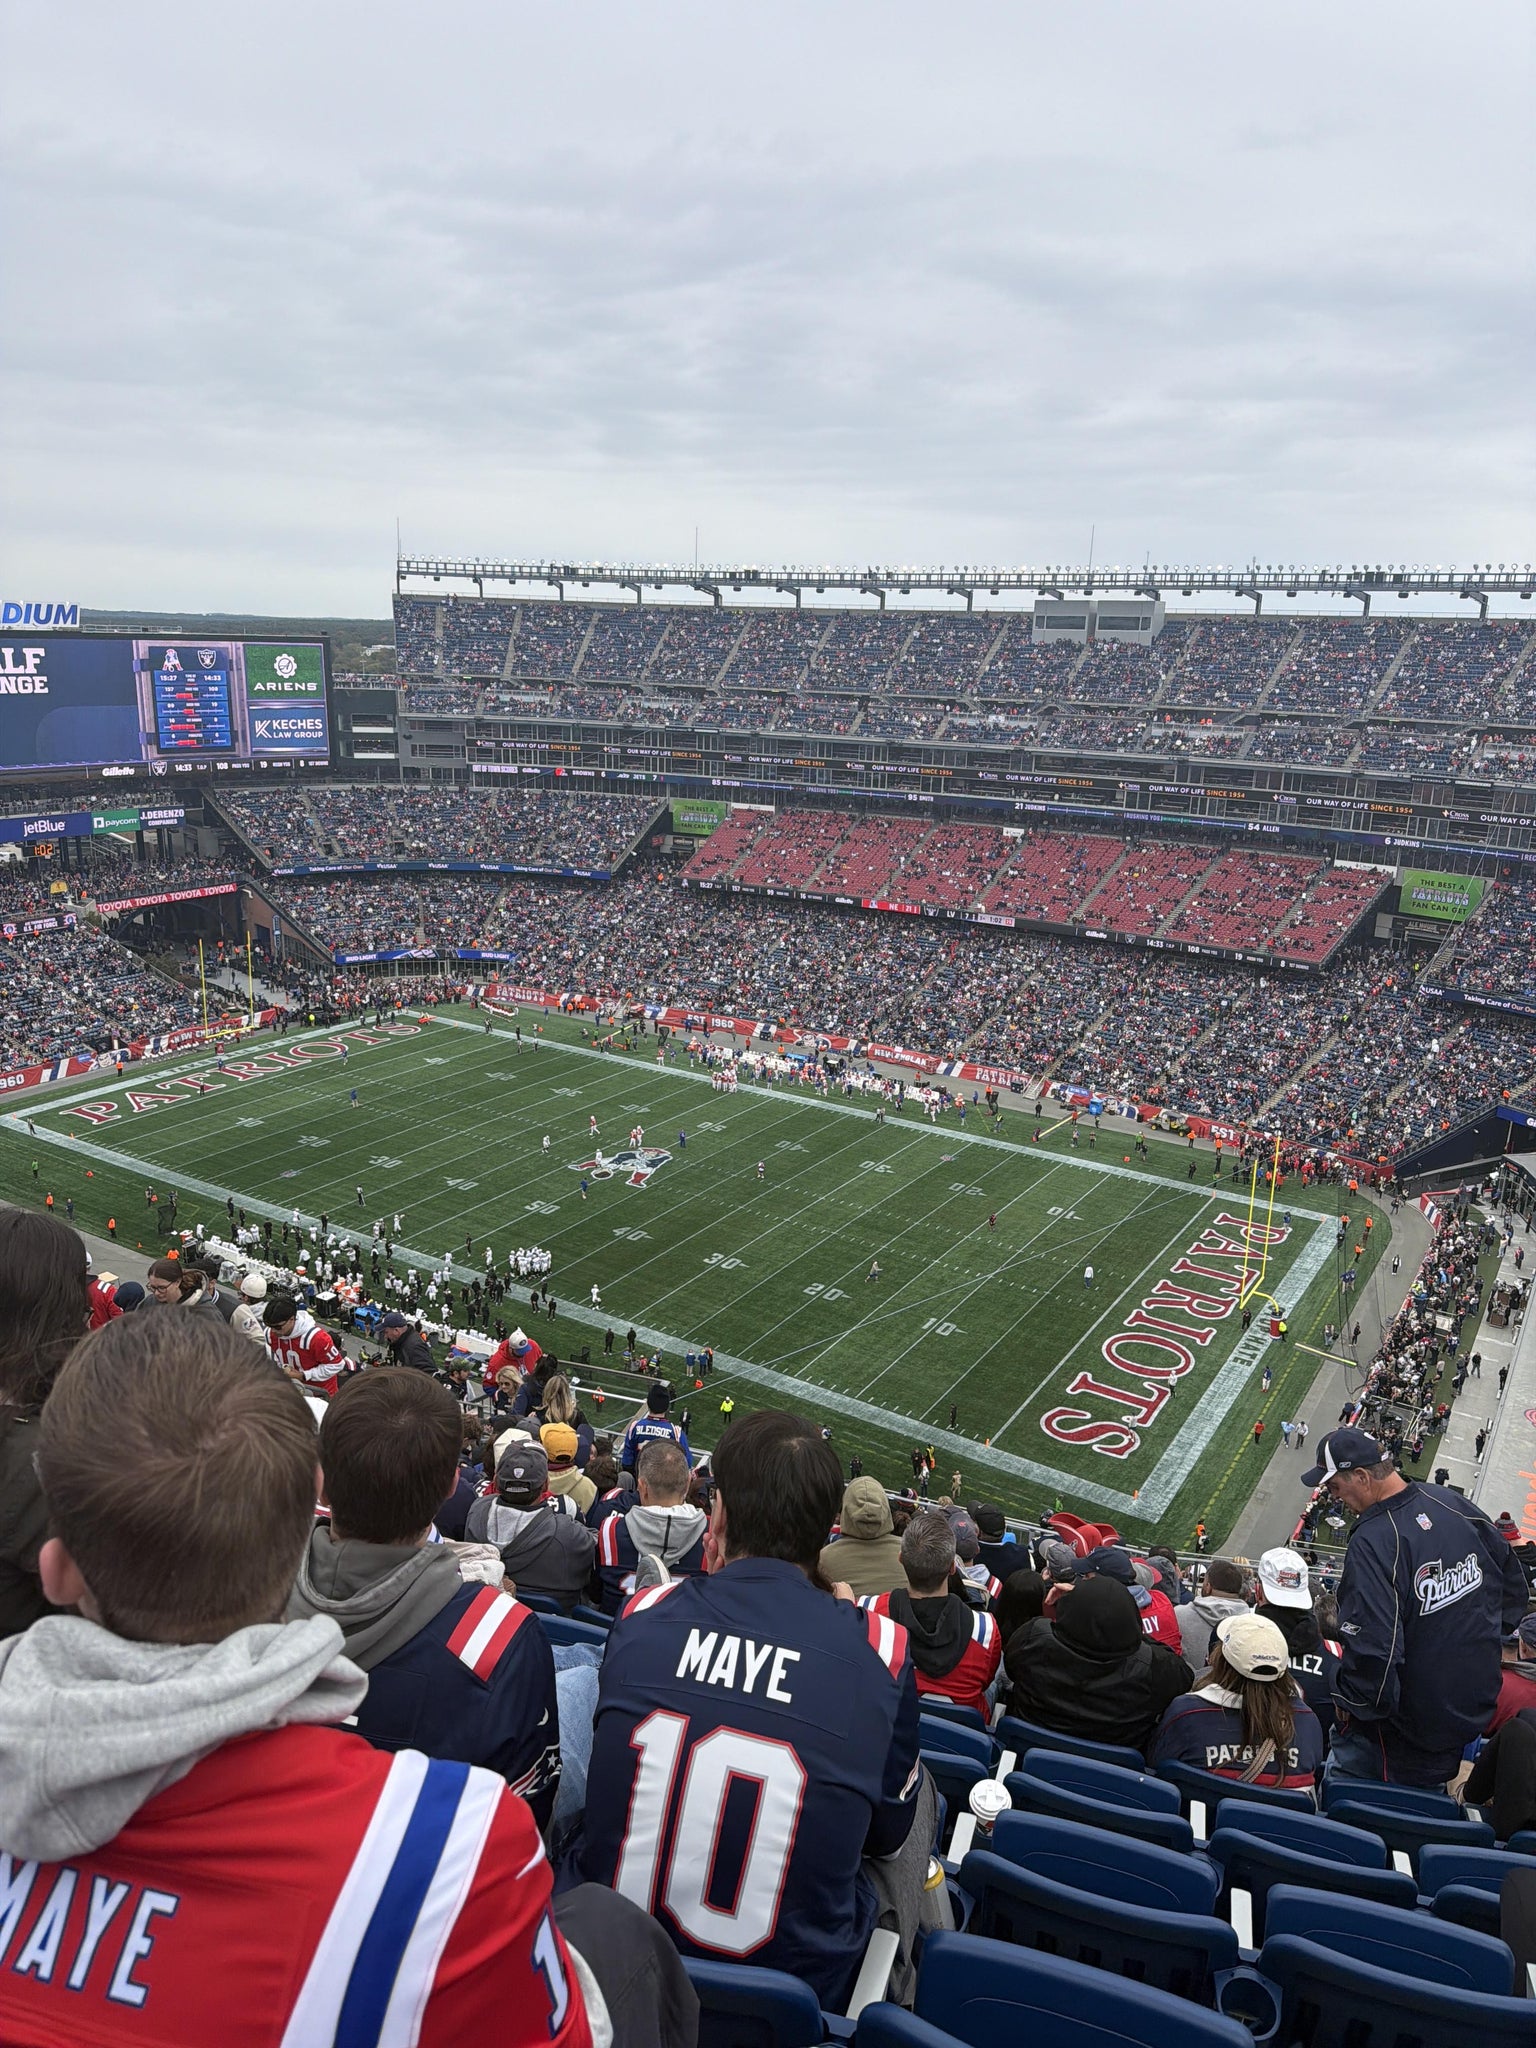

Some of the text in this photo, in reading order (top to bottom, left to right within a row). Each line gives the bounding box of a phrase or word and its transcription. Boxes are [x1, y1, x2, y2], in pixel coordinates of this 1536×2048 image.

[1, 602, 78, 625] DIUM
[0, 647, 45, 674] LF
[0, 676, 48, 694] NGE
[254, 682, 318, 691] ARIENS
[272, 718, 323, 730] KECHES
[273, 730, 323, 739] LAW GROUP
[175, 764, 193, 772] 14:33
[216, 762, 229, 770] 108
[259, 761, 267, 769] 19
[871, 764, 884, 772] OUR
[907, 766, 920, 774] LIFE
[1190, 788, 1205, 796] LIFE
[1206, 789, 1226, 797] SINCE
[1014, 802, 1024, 810] 21
[1306, 797, 1413, 814] OUR WAY OF LIFE SINCE 1954
[105, 816, 137, 828] paycom
[140, 808, 185, 821] J.DERENZO
[147, 818, 178, 826] COMPANIES
[1480, 814, 1498, 823] OUR
[1500, 816, 1517, 824] WAY
[1519, 818, 1532, 826] OF
[23, 820, 65, 837] jetBlue
[1248, 823, 1260, 831] 54
[1262, 824, 1280, 833] ALLEN
[1384, 837, 1391, 845] 6
[1393, 837, 1420, 848] JUDKINS
[34, 844, 54, 856] 1:02
[203, 884, 235, 896] TOYOTA
[1420, 879, 1466, 891] THE BEST A
[134, 895, 168, 907] TOYOTA
[168, 889, 202, 902] TOYOTA
[1411, 886, 1470, 906] PATRIOTS
[99, 900, 133, 913] TOYOTA
[888, 903, 898, 911] NE
[1412, 901, 1467, 915] FAN CAN GET
[989, 916, 1003, 924] 1:02
[1146, 938, 1164, 948] 14:33
[1187, 945, 1200, 954] 108
[345, 953, 377, 962] BUD LIGHT
[1235, 952, 1243, 961] 19
[1280, 959, 1286, 968] 8
[496, 986, 545, 1003] PATRIOTS
[1425, 987, 1443, 996] USAA
[1464, 993, 1524, 1011] Taking Care of Our
[711, 1017, 734, 1028] 1960
[894, 1052, 927, 1066] ENGLAN
[0, 1073, 25, 1089] 960
[59, 1022, 423, 1127] PATRIOTS
[524, 1200, 561, 1215] 50
[612, 1226, 648, 1241] 40
[703, 1252, 742, 1270] 30
[802, 1282, 845, 1301] 20
[921, 1317, 958, 1336] 10
[1040, 1212, 1293, 1460] PATRIOTS
[326, 1345, 339, 1361] 10
[1232, 1334, 1268, 1367] HATE
[635, 1421, 672, 1438] BLEDSOE
[1419, 1555, 1482, 1612] Patriots
[1142, 1615, 1160, 1635] DY
[675, 1628, 801, 1704] MAYE
[1288, 1653, 1323, 1676] LEZ
[1205, 1744, 1299, 1768] PATRS
[612, 1707, 808, 1959] 10
[0, 1849, 180, 2009] MAYE
